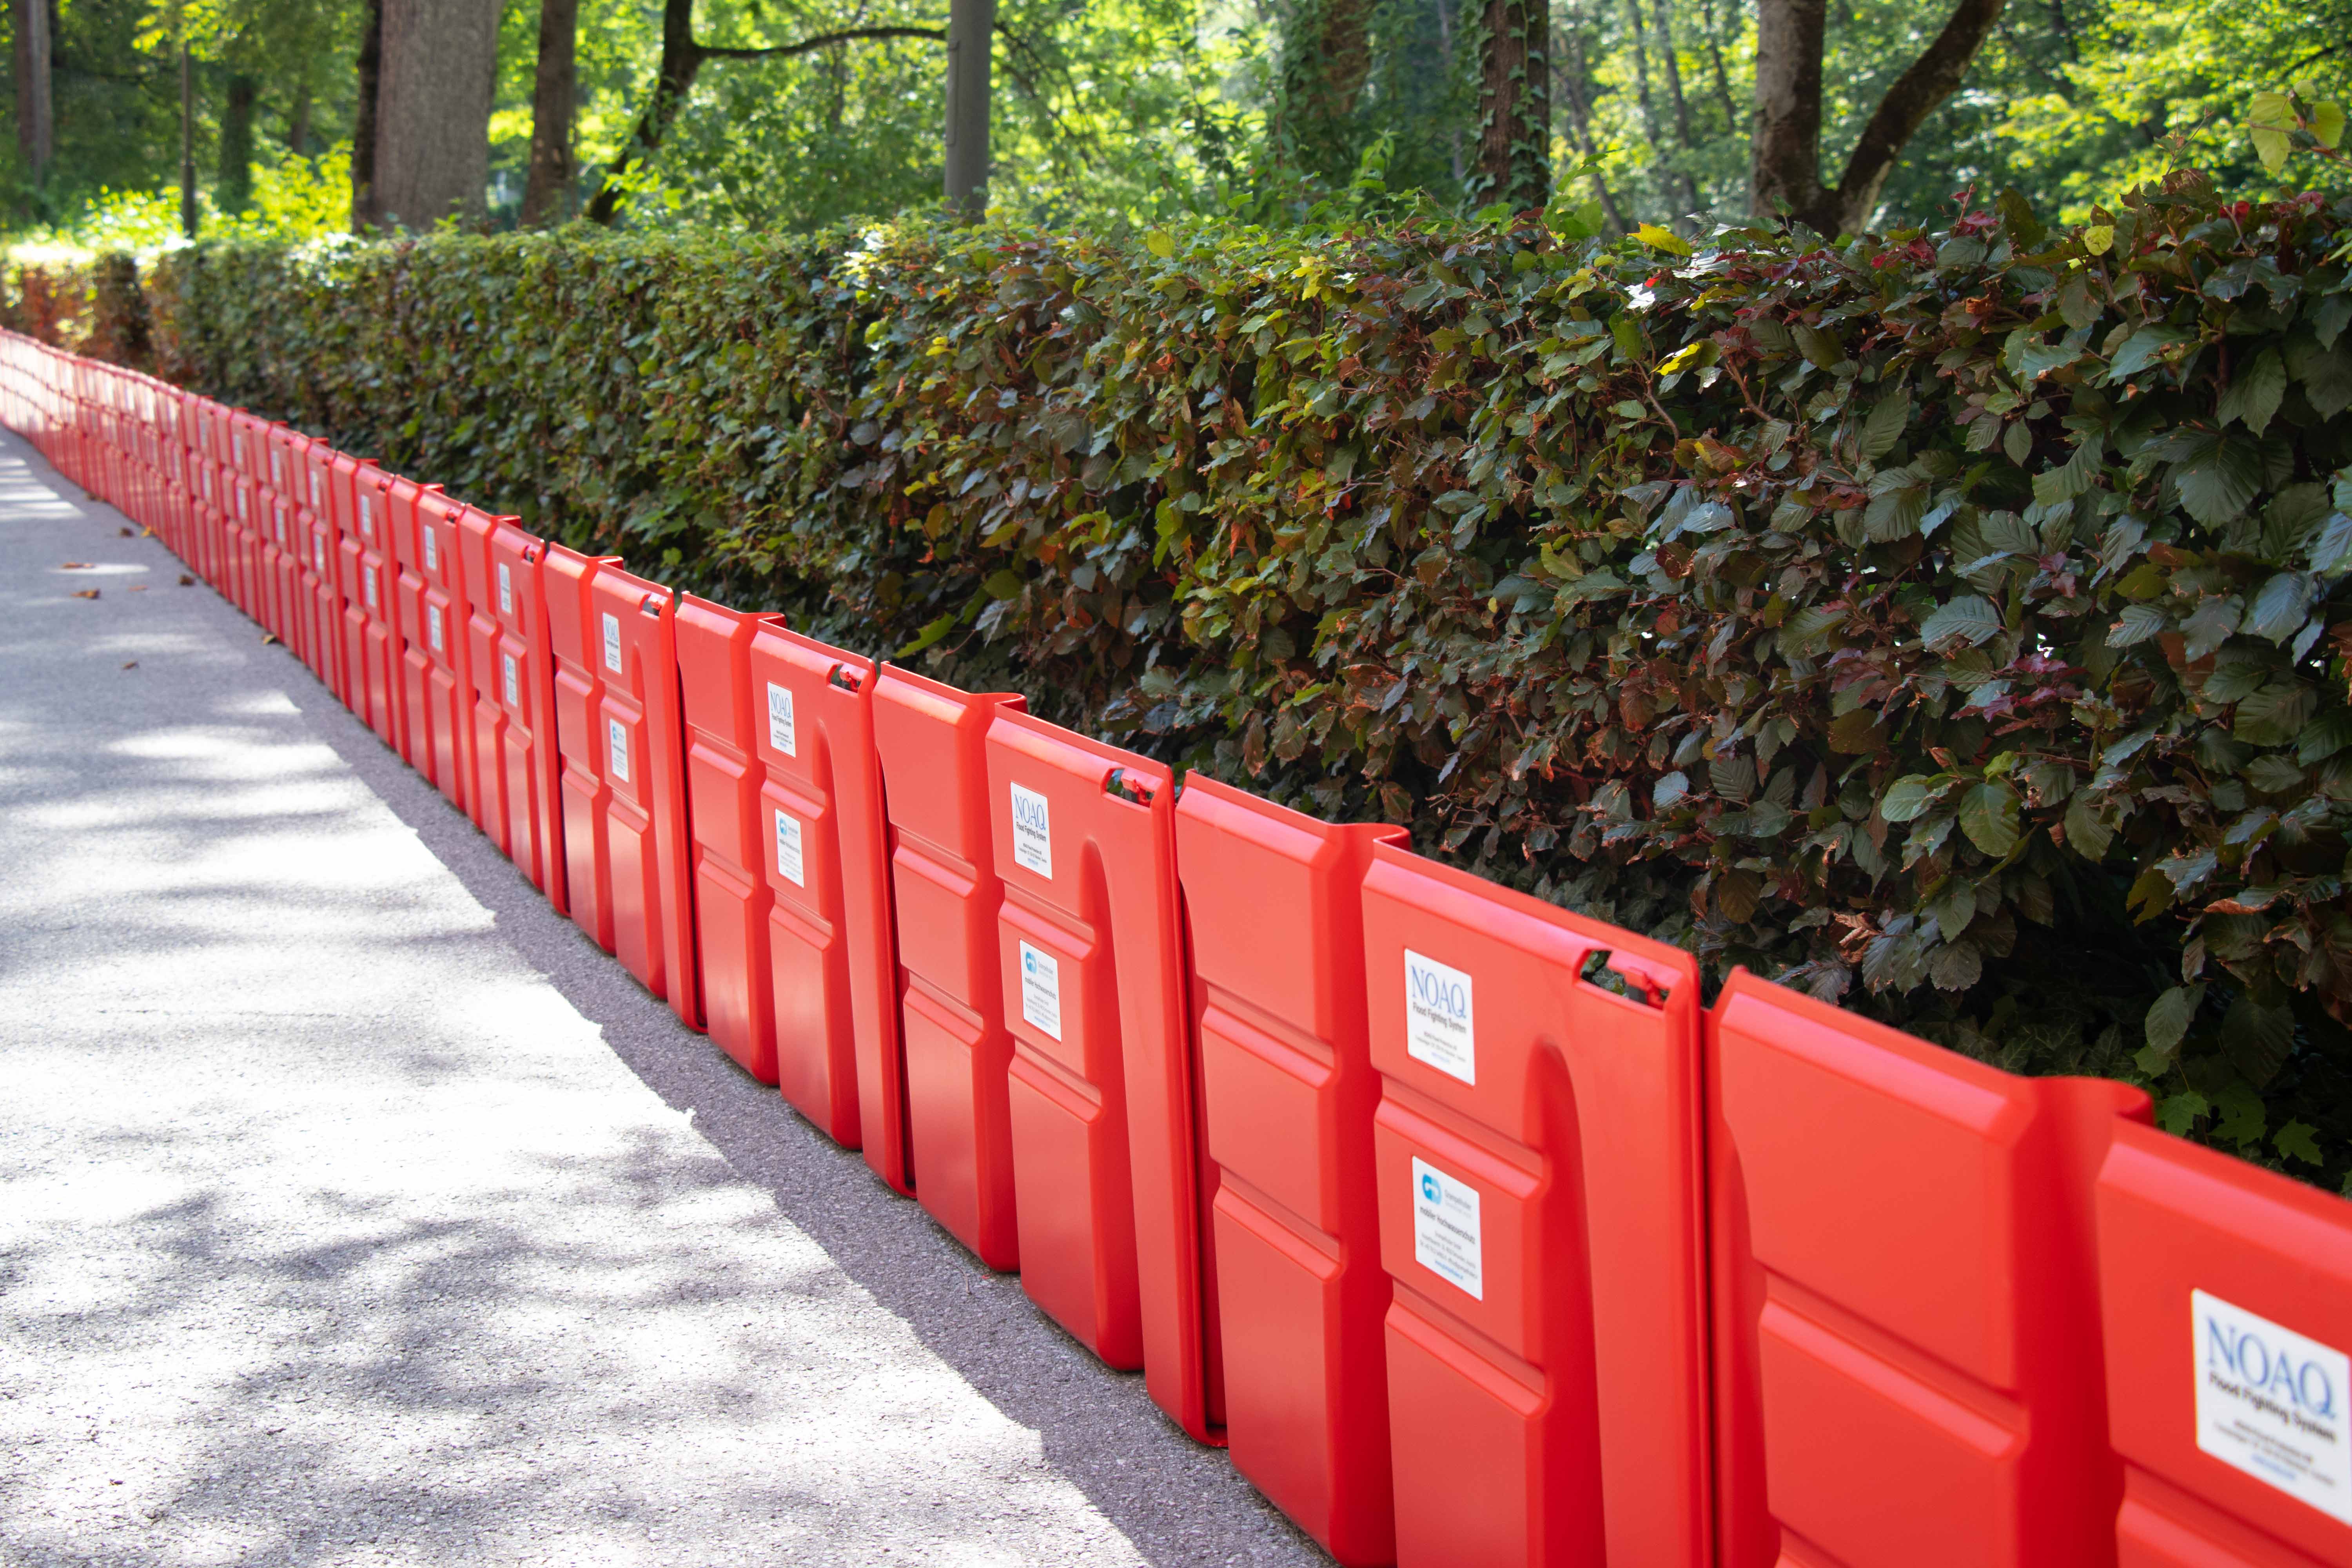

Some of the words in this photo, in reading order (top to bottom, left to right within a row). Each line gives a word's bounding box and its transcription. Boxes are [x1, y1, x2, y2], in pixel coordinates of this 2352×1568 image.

[770, 691, 791, 718] NOAQ
[1014, 794, 1046, 830] NOAQ
[1024, 825, 1036, 839] Fighting
[1036, 831, 1046, 842] System
[1411, 965, 1466, 1019] NOAQ
[1413, 1002, 1426, 1017] Flood
[1427, 1008, 1447, 1028] Fighting
[1448, 1018, 1466, 1034] System
[2207, 1315, 2336, 1419] NOAQ
[2209, 1372, 2241, 1397] Flood
[2242, 1389, 2290, 1425] Fighting
[2292, 1412, 2337, 1443] System
